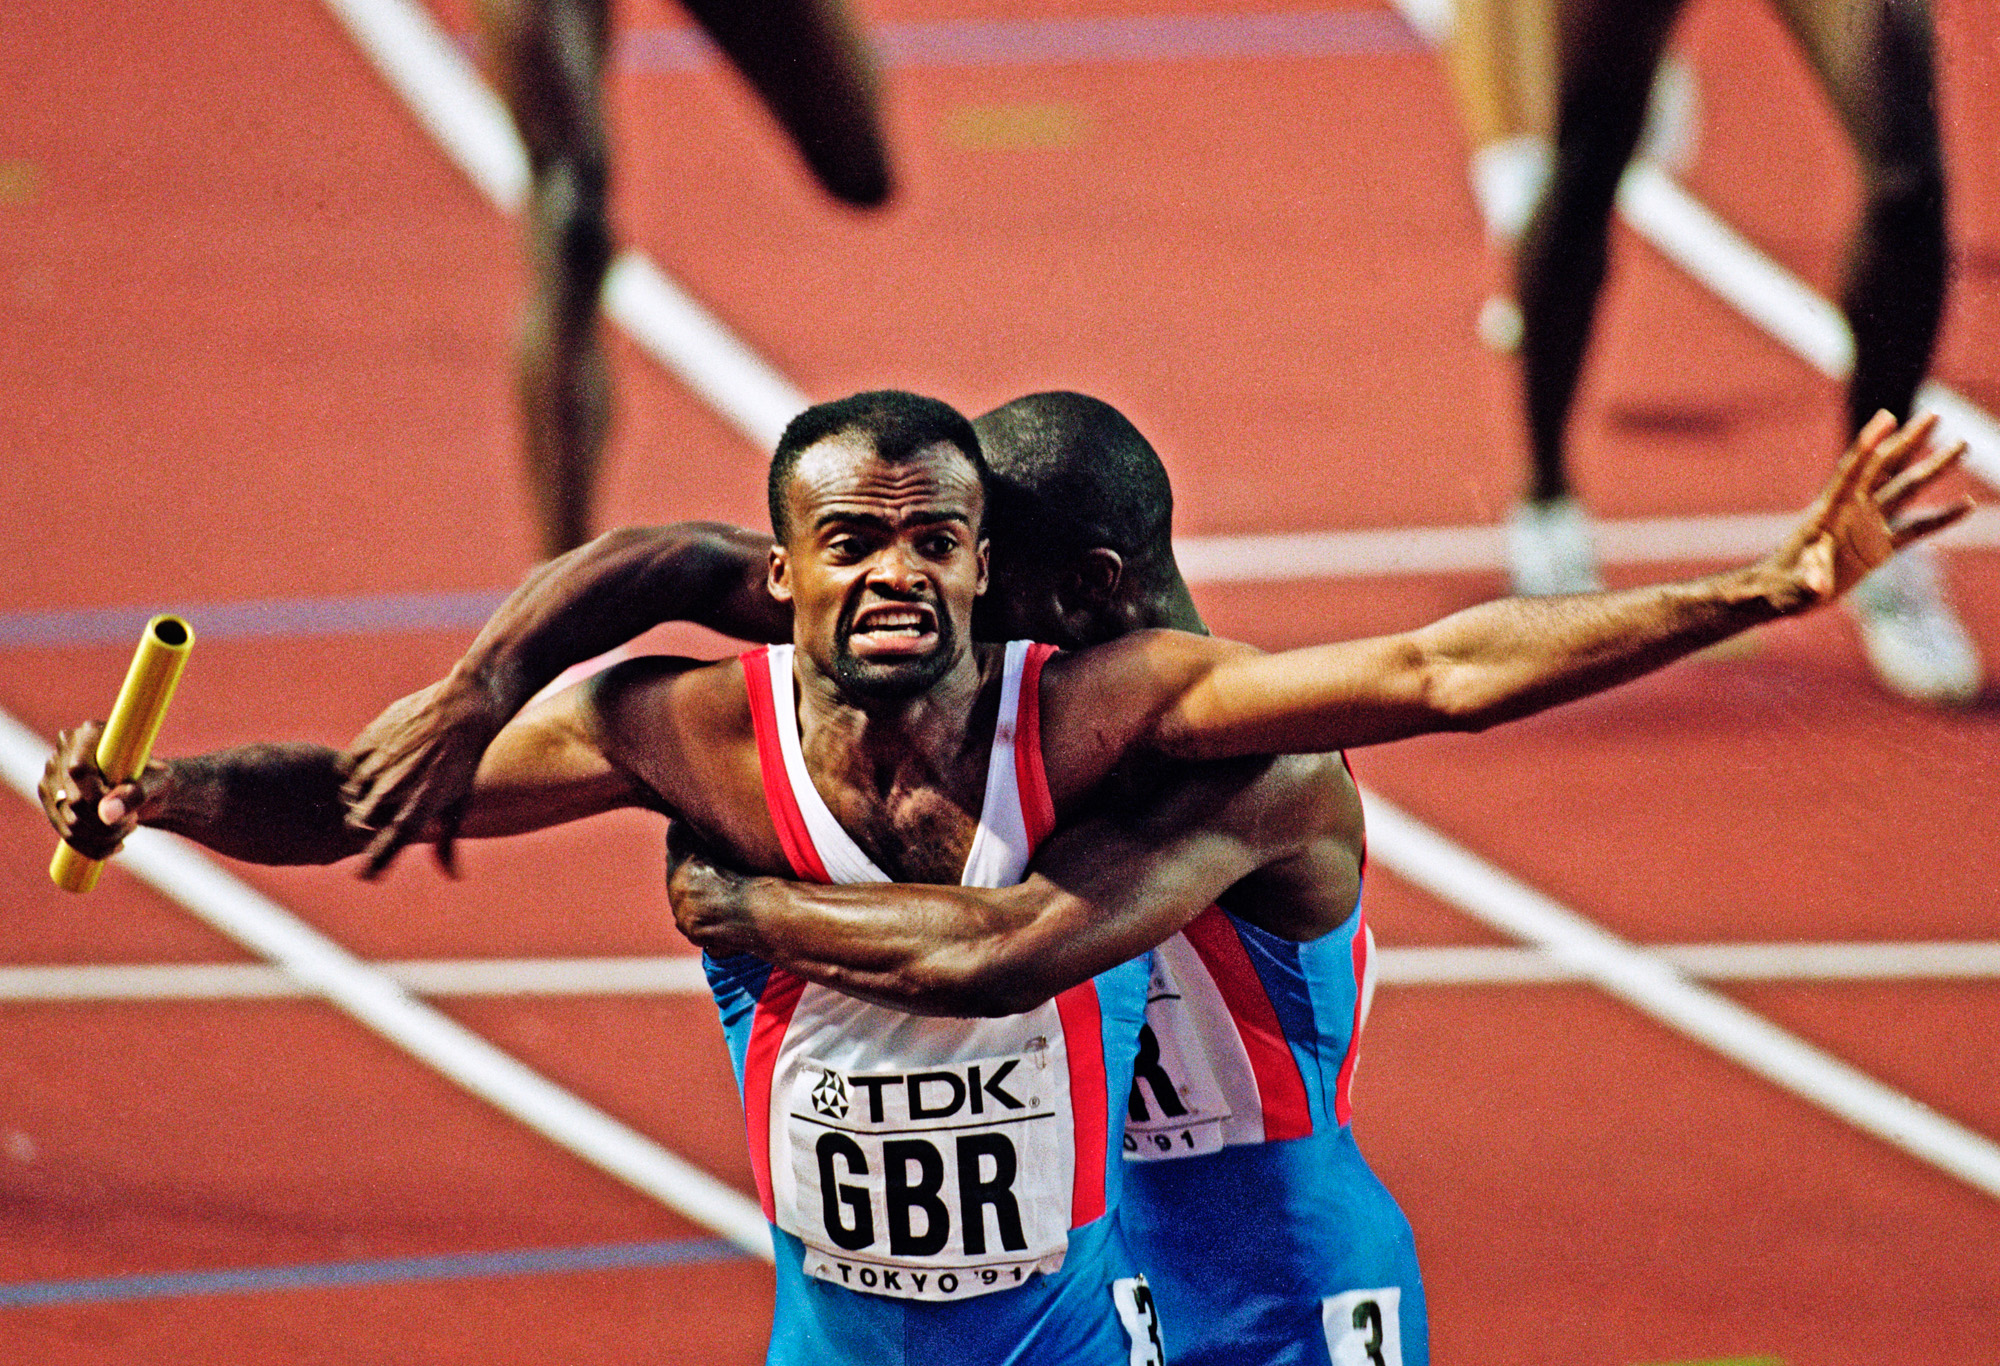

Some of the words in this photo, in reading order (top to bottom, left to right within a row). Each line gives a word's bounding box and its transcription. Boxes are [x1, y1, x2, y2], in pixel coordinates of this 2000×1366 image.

[847, 1059, 1026, 1123] TDK
[815, 1132, 1029, 1256] GBR
[837, 1263, 959, 1293] TOKYO
[974, 1267, 1022, 1286] '91
